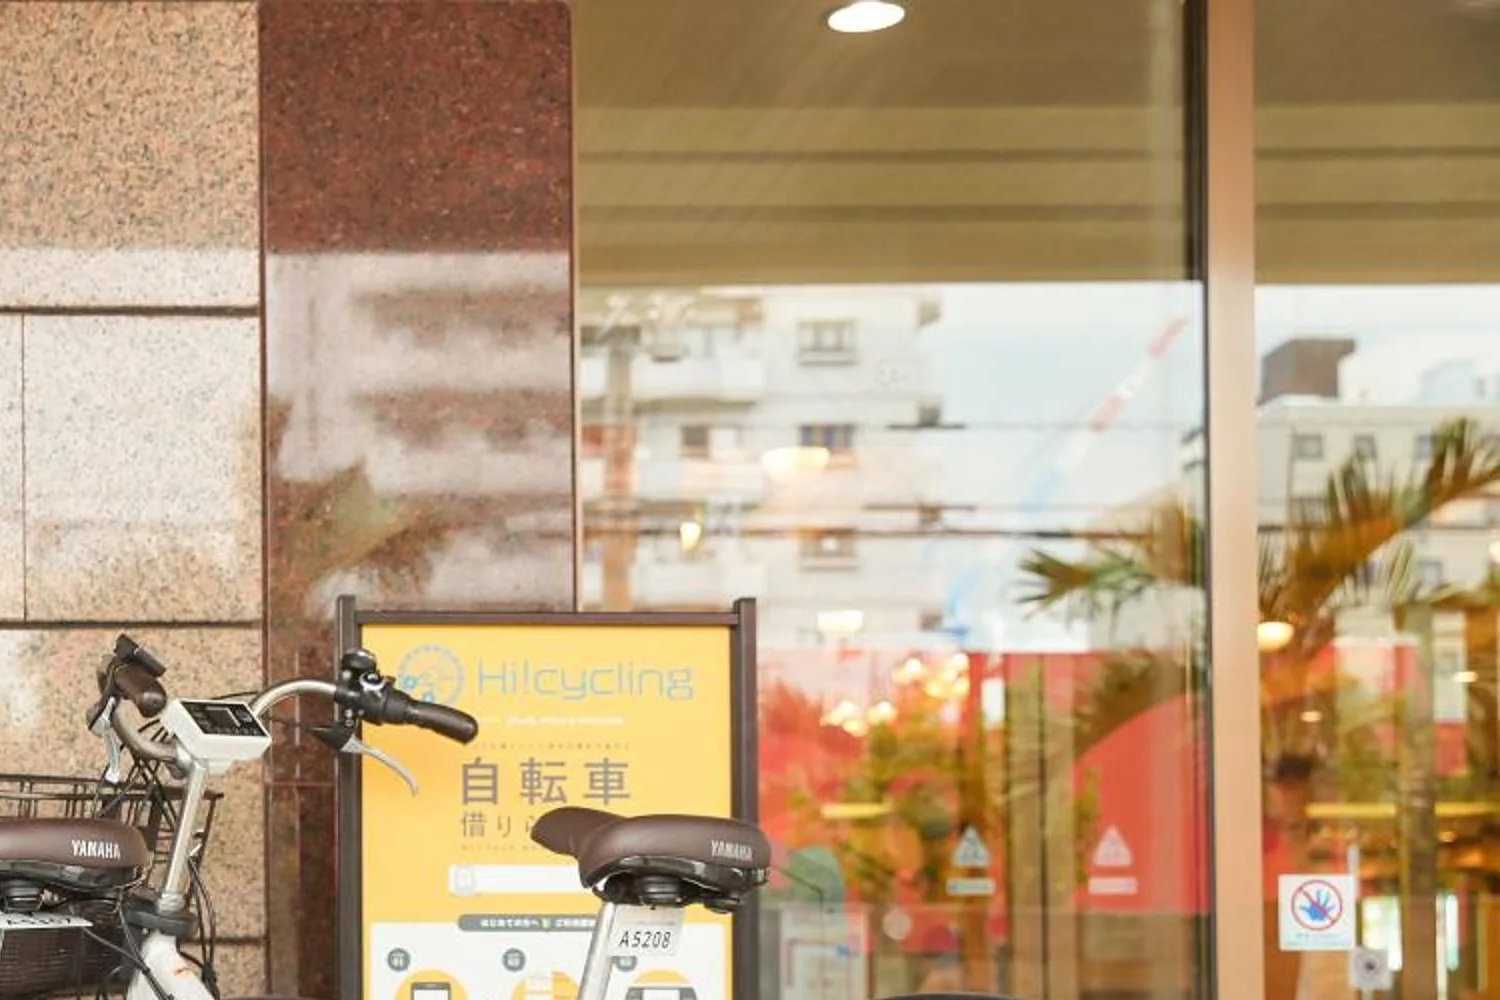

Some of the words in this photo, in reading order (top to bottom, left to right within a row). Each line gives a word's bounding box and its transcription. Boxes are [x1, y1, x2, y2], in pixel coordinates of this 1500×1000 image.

[476, 657, 696, 701] Hi!cycling
[460, 756, 632, 806] 自転車
[71, 839, 121, 860] YAMAHA
[710, 838, 754, 863] YAMAHA
[618, 929, 673, 949] A5208
